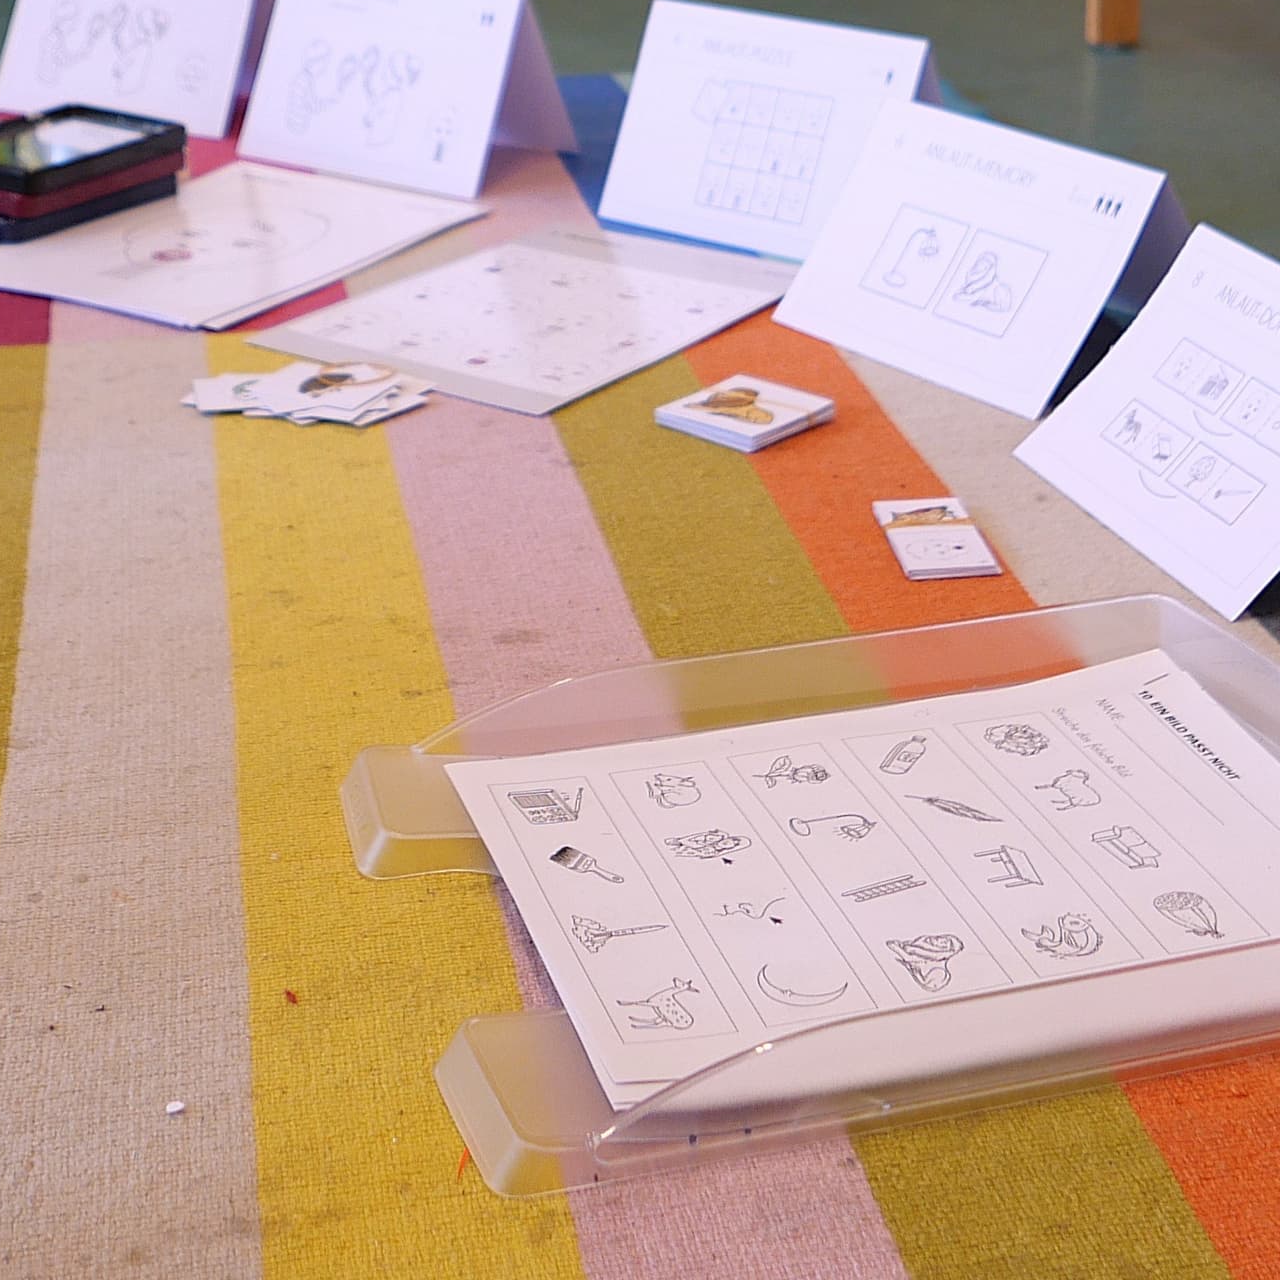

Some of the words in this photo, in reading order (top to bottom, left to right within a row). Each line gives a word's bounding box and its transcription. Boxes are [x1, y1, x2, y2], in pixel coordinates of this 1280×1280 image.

[1138, 689, 1154, 701] 10
[1149, 701, 1170, 716] EIN
[1164, 715, 1189, 734] BILD
[1183, 733, 1215, 758] PASST
[1208, 757, 1241, 781] NICHT
